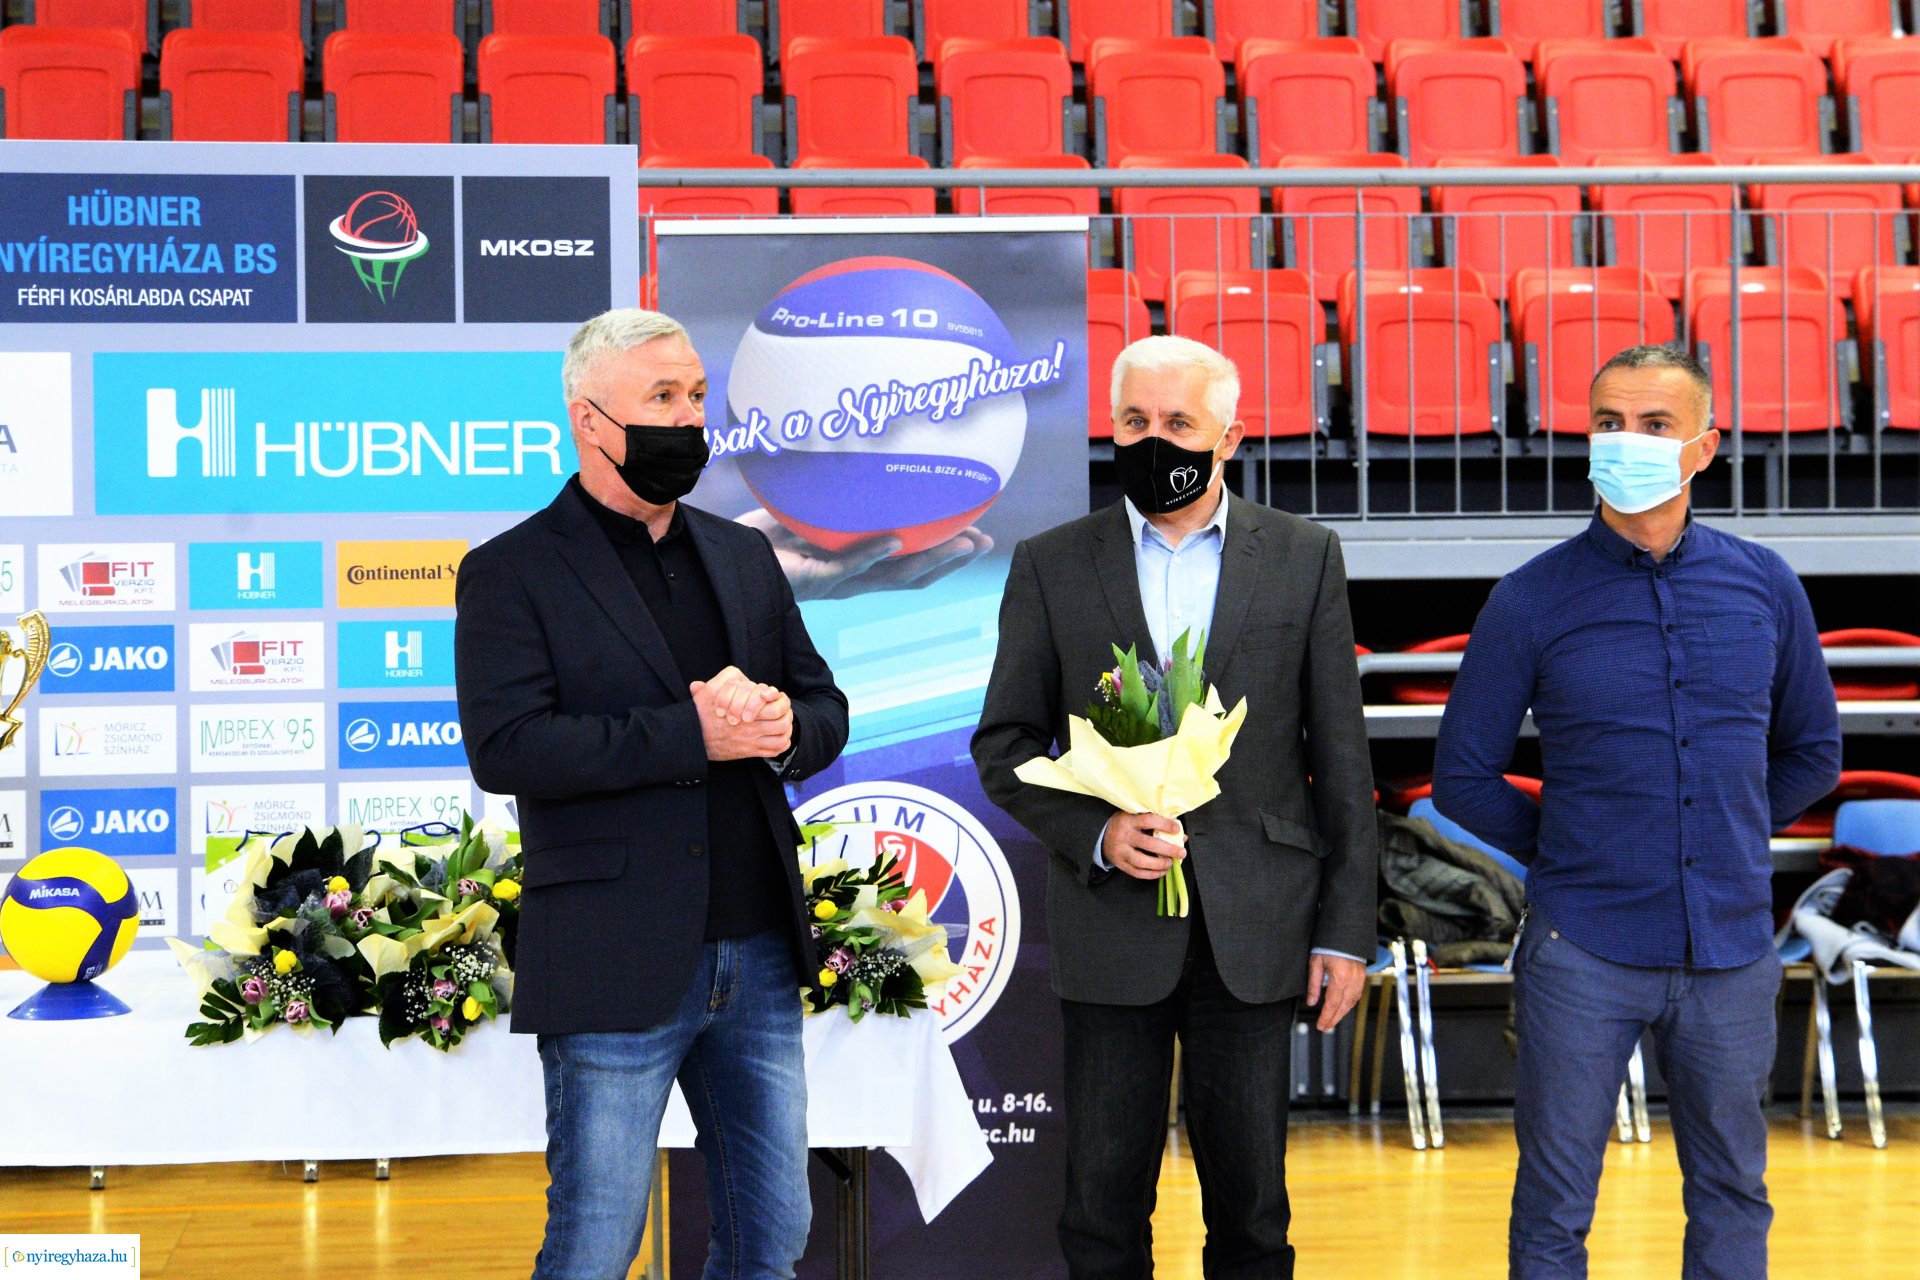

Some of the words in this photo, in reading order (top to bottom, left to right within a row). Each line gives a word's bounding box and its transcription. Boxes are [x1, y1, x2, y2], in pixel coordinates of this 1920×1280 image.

[67, 188, 202, 227] HÜBNER
[0, 235, 225, 274] NYÍREGYHÁZA
[234, 242, 279, 275] BS
[480, 239, 595, 257] MKOSZ
[17, 284, 66, 307] FÉRFI
[70, 284, 185, 307] KOSÁRLABDA
[188, 287, 254, 307] CSAPAT
[771, 306, 885, 329] Pro-Line
[891, 307, 939, 329] 10
[784, 413, 811, 439] a
[254, 420, 564, 477] HÜBNER
[885, 463, 932, 474] OFFICIAL
[934, 465, 957, 476] SIZE
[964, 468, 994, 485] WEIGHT
[111, 561, 155, 578] FIT
[346, 564, 442, 586] Continental
[89, 645, 169, 672] JAKO
[261, 640, 305, 657] FIT
[104, 733, 163, 744] ZSIGMOND
[200, 719, 276, 757] IMBREX
[387, 721, 462, 747] JAKO
[91, 808, 170, 835] JAKO
[254, 811, 312, 822] ZSIGMOND
[348, 795, 423, 828] IMBREX
[978, 1098, 998, 1114] u.
[1002, 1092, 1053, 1113] 8-16.
